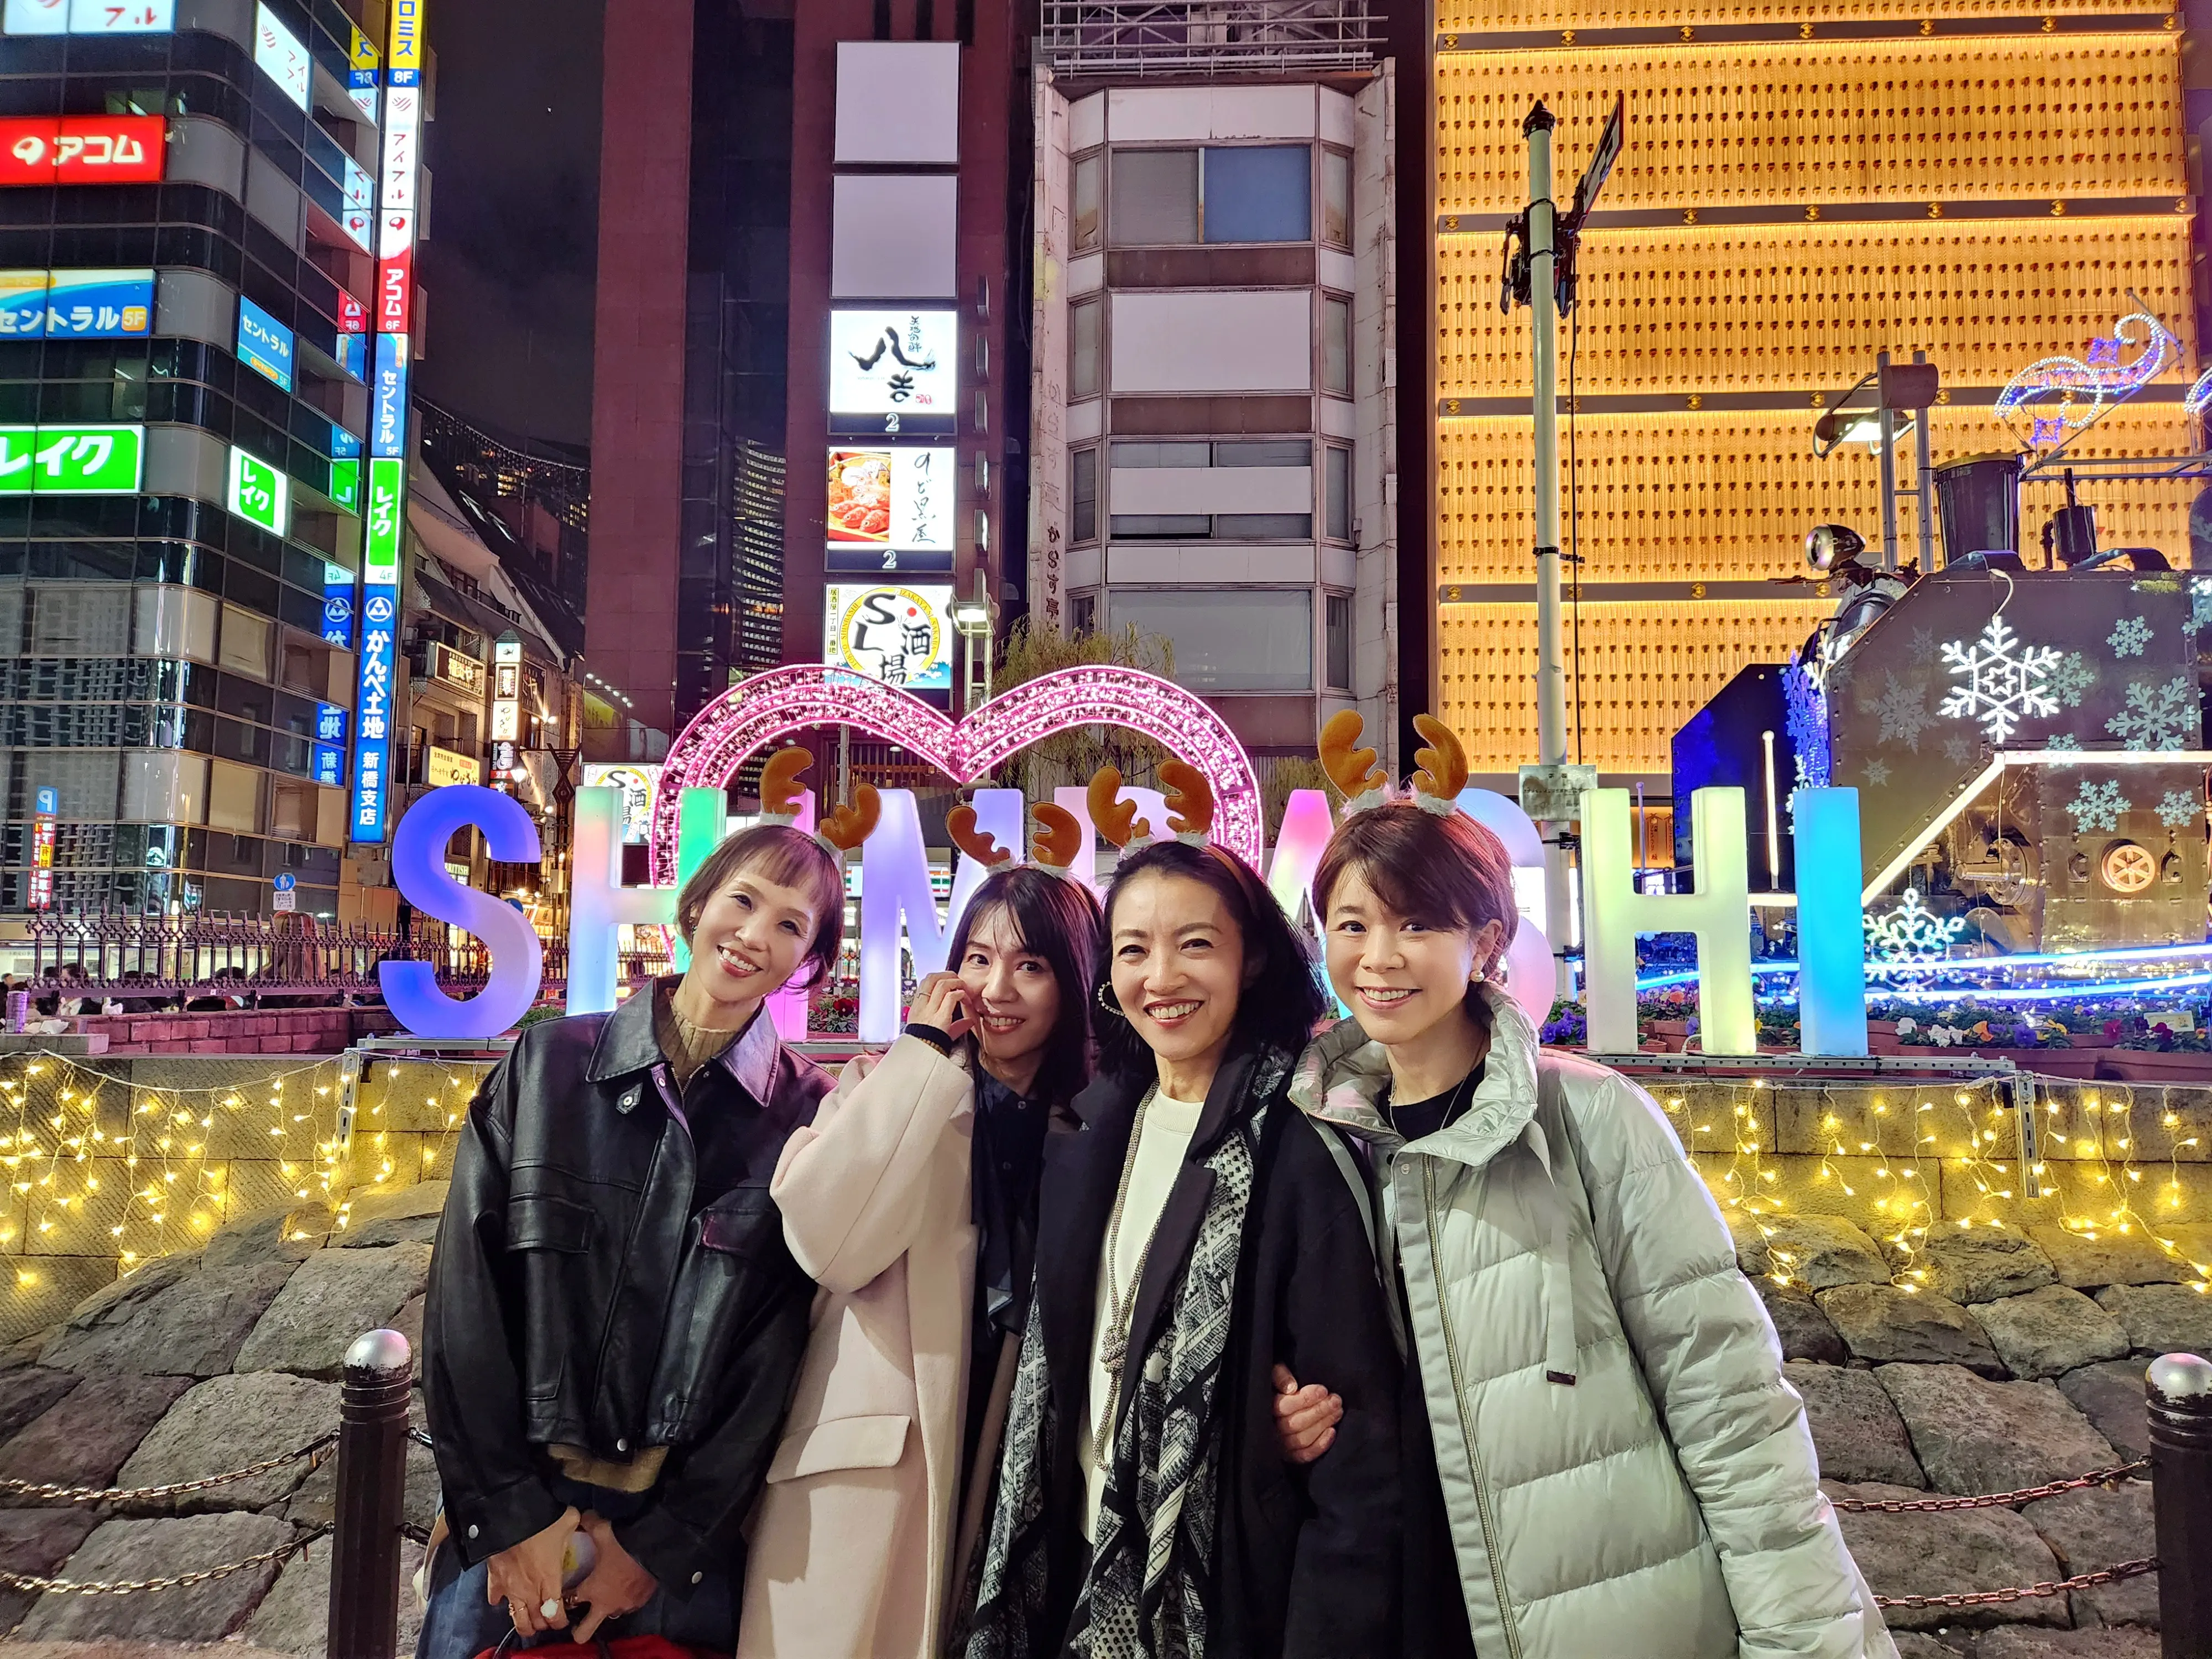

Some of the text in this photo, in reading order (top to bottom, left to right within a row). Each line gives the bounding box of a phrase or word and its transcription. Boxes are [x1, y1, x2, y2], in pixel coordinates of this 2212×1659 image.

[105, 7, 156, 27] フル
[394, 72, 413, 84] 8F
[52, 134, 143, 166] アコム
[391, 134, 406, 200] アイフル
[385, 269, 404, 316] アコム
[0, 306, 145, 332] セントラル 5F
[385, 321, 400, 330] 6F
[243, 314, 290, 358] セントラル
[379, 370, 398, 444] セントラル
[885, 413, 900, 432] 2
[0, 435, 114, 476] レイク
[385, 446, 400, 456] 5F
[241, 460, 269, 511] レイク
[372, 486, 394, 536] レイク
[379, 570, 393, 581] 4F
[882, 550, 897, 569] 2
[899, 589, 927, 611] IZAKAYA
[362, 630, 390, 739] かんべ土地
[359, 752, 380, 826] 新橋支店
